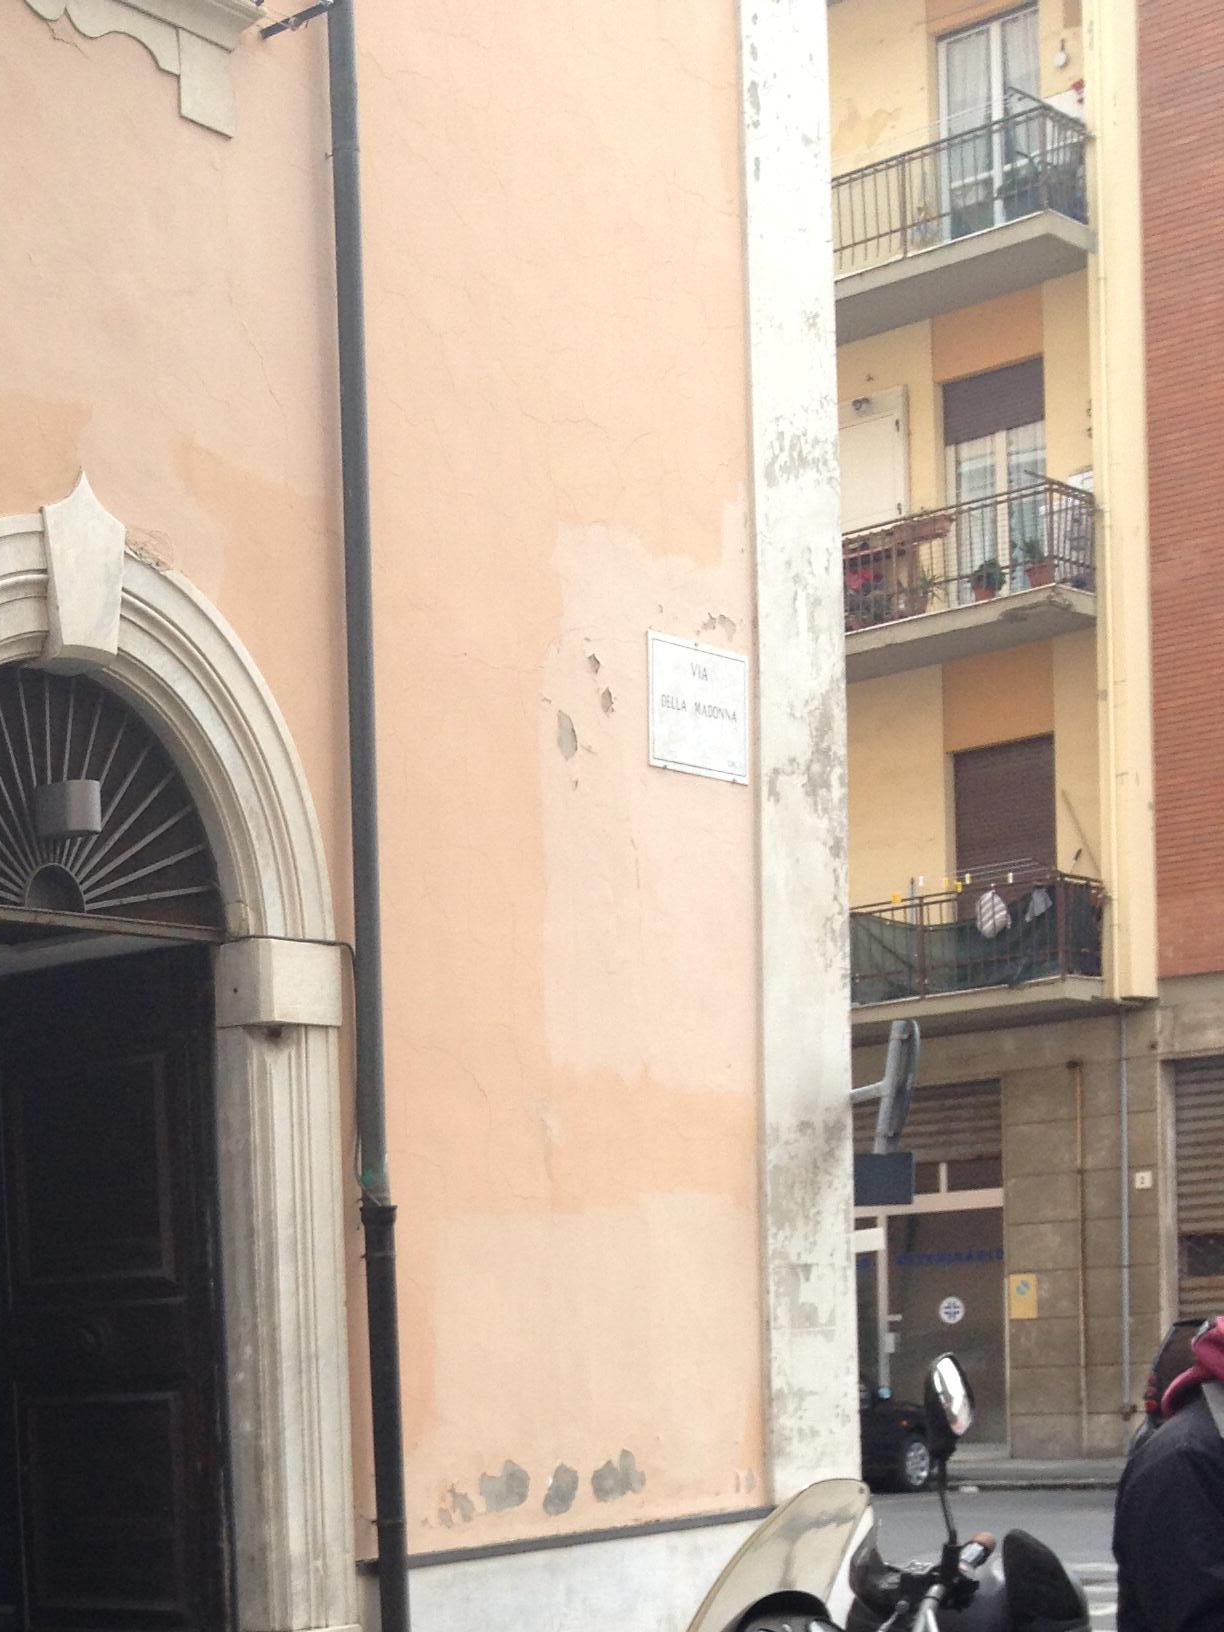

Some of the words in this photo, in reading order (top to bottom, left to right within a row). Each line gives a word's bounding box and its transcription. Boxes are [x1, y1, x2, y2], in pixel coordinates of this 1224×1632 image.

[691, 662, 708, 681] VIA
[661, 693, 687, 712] DELLA
[694, 701, 737, 722] MADONNA
